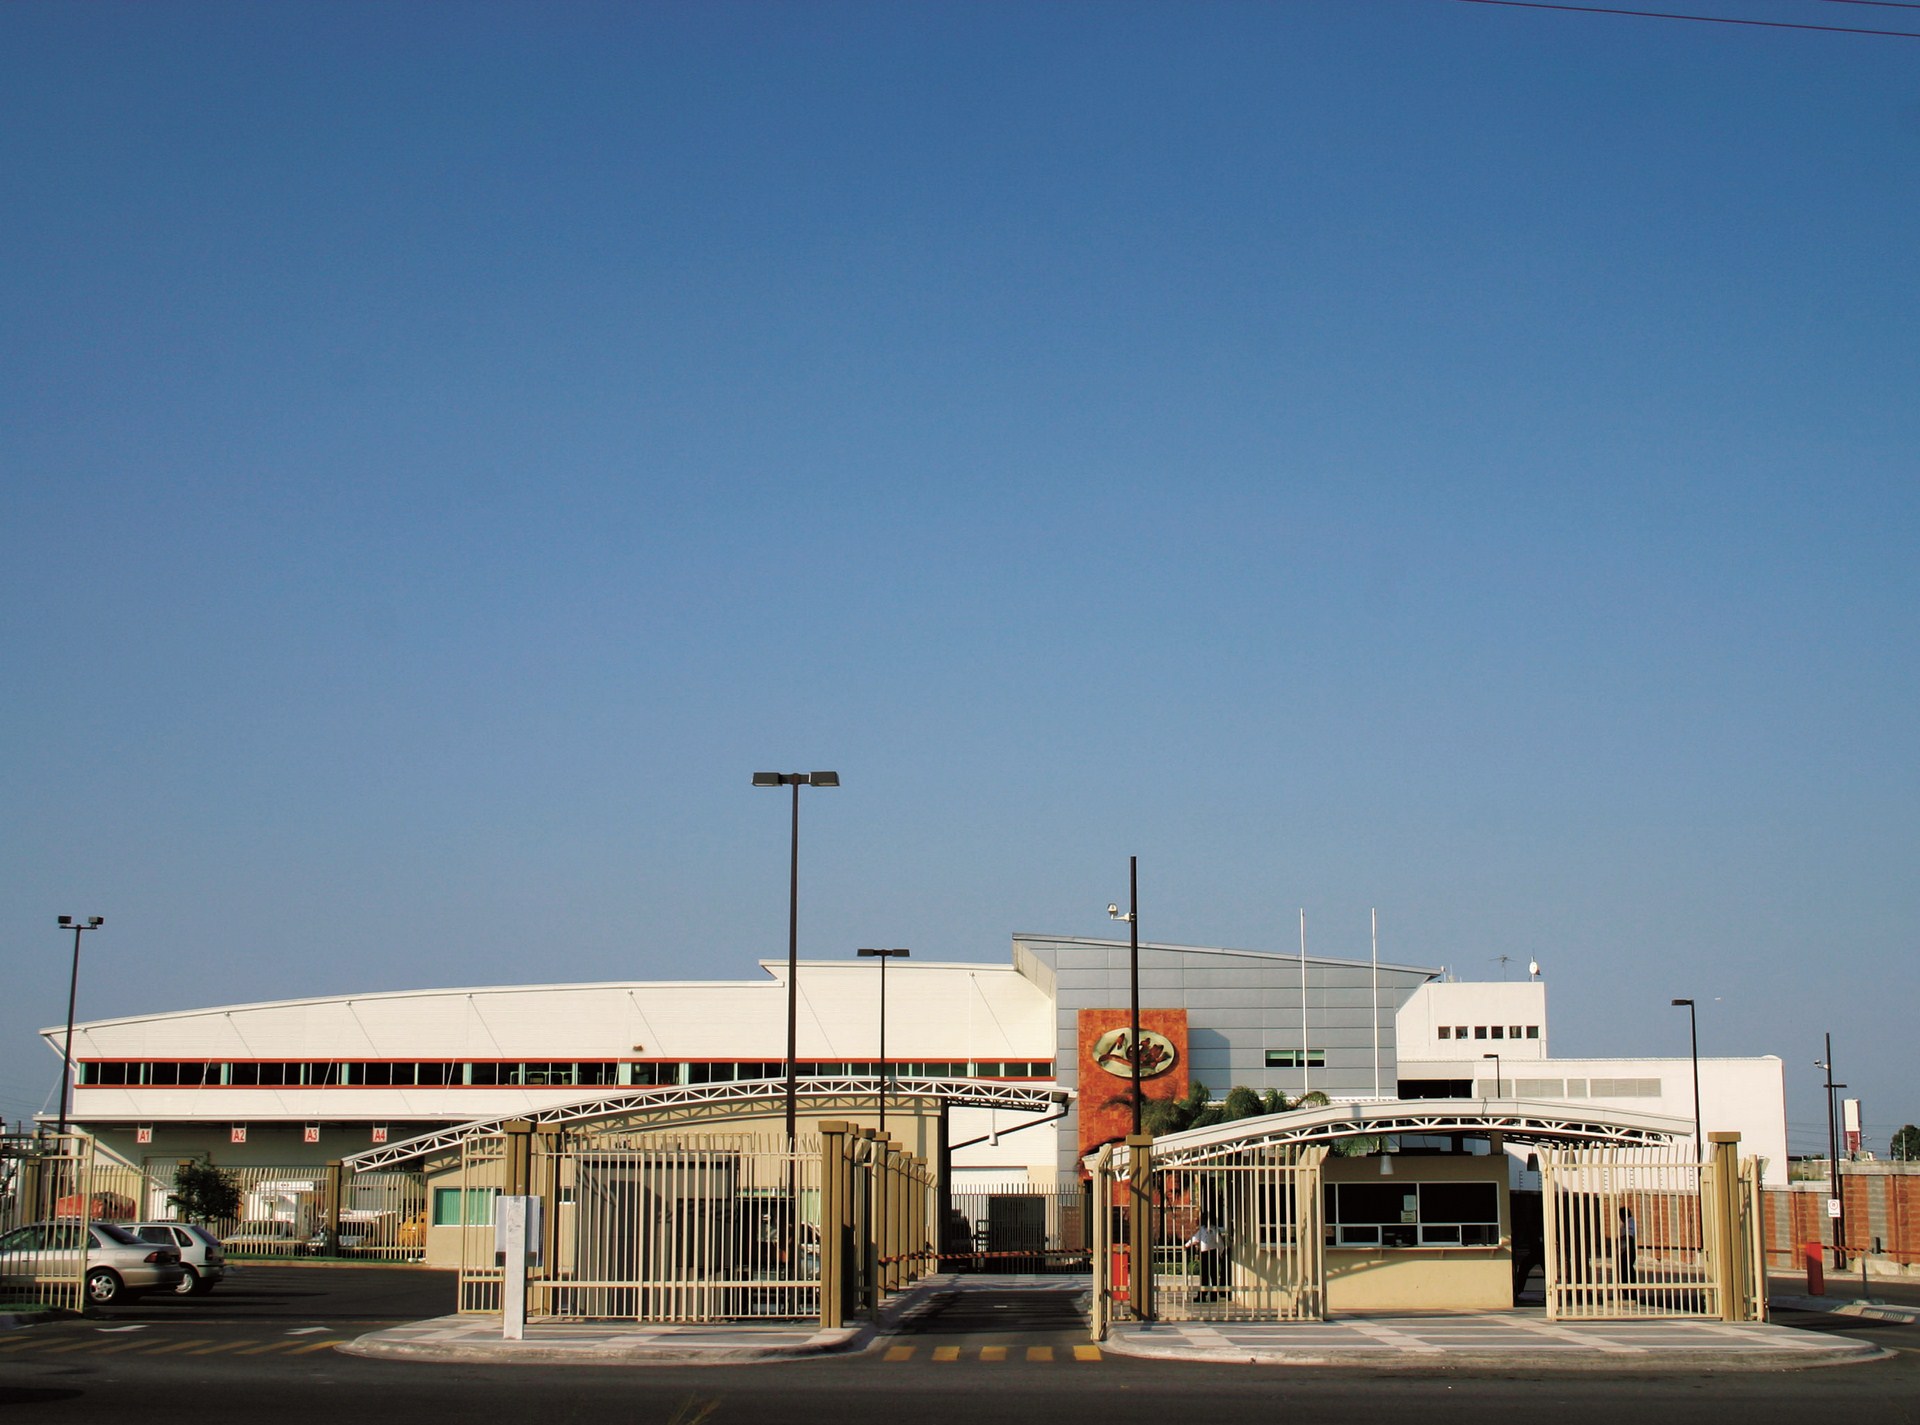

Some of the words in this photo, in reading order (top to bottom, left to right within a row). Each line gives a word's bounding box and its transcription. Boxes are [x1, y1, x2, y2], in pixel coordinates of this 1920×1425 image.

[140, 1130, 150, 1141] A1
[233, 1130, 245, 1141] A2
[307, 1129, 318, 1141] A3
[374, 1129, 385, 1140] A4
